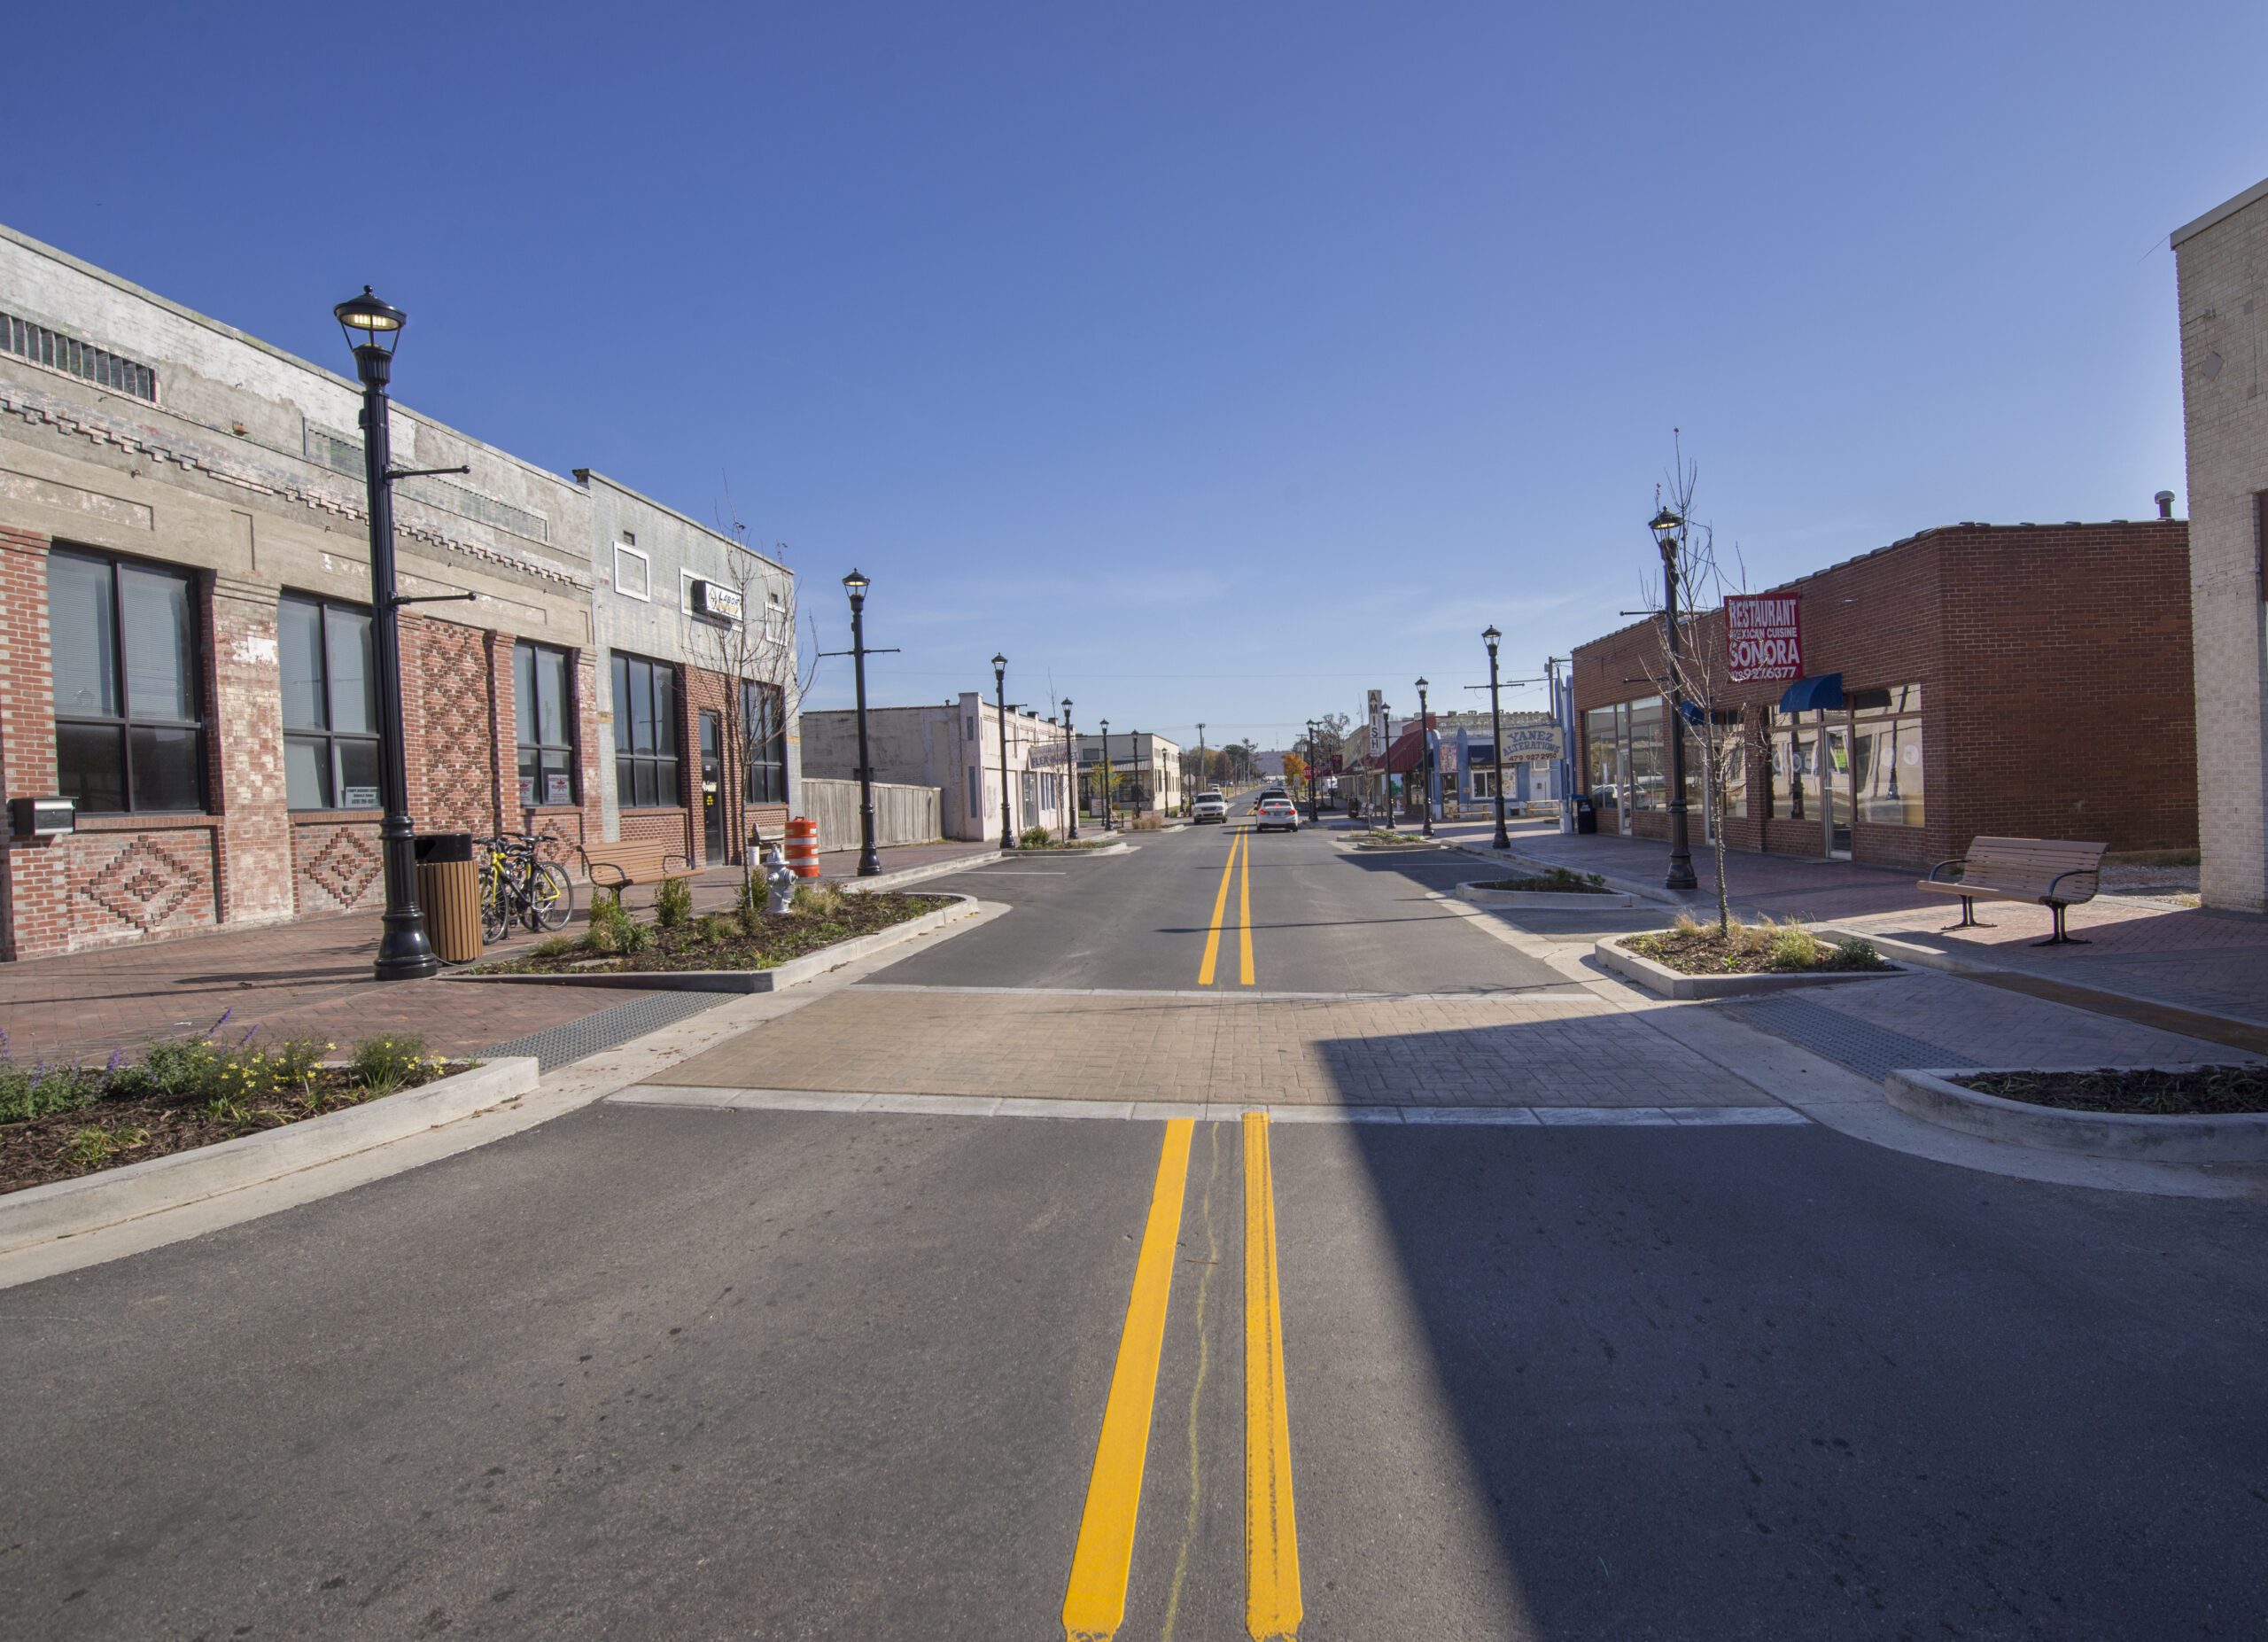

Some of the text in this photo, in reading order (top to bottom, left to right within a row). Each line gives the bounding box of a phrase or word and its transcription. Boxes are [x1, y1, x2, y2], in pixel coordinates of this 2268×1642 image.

[718, 591, 740, 606] LABOR
[1728, 600, 1796, 627] RESTAURANT
[1729, 627, 1797, 640] MEXICAN CUISINE
[1729, 640, 1800, 666] SONORA
[1370, 691, 1379, 749] AMISH
[1507, 731, 1554, 743] YANEZ
[1503, 741, 1561, 756] ALTERATIONS
[1031, 752, 1077, 766] FLEA MARET
